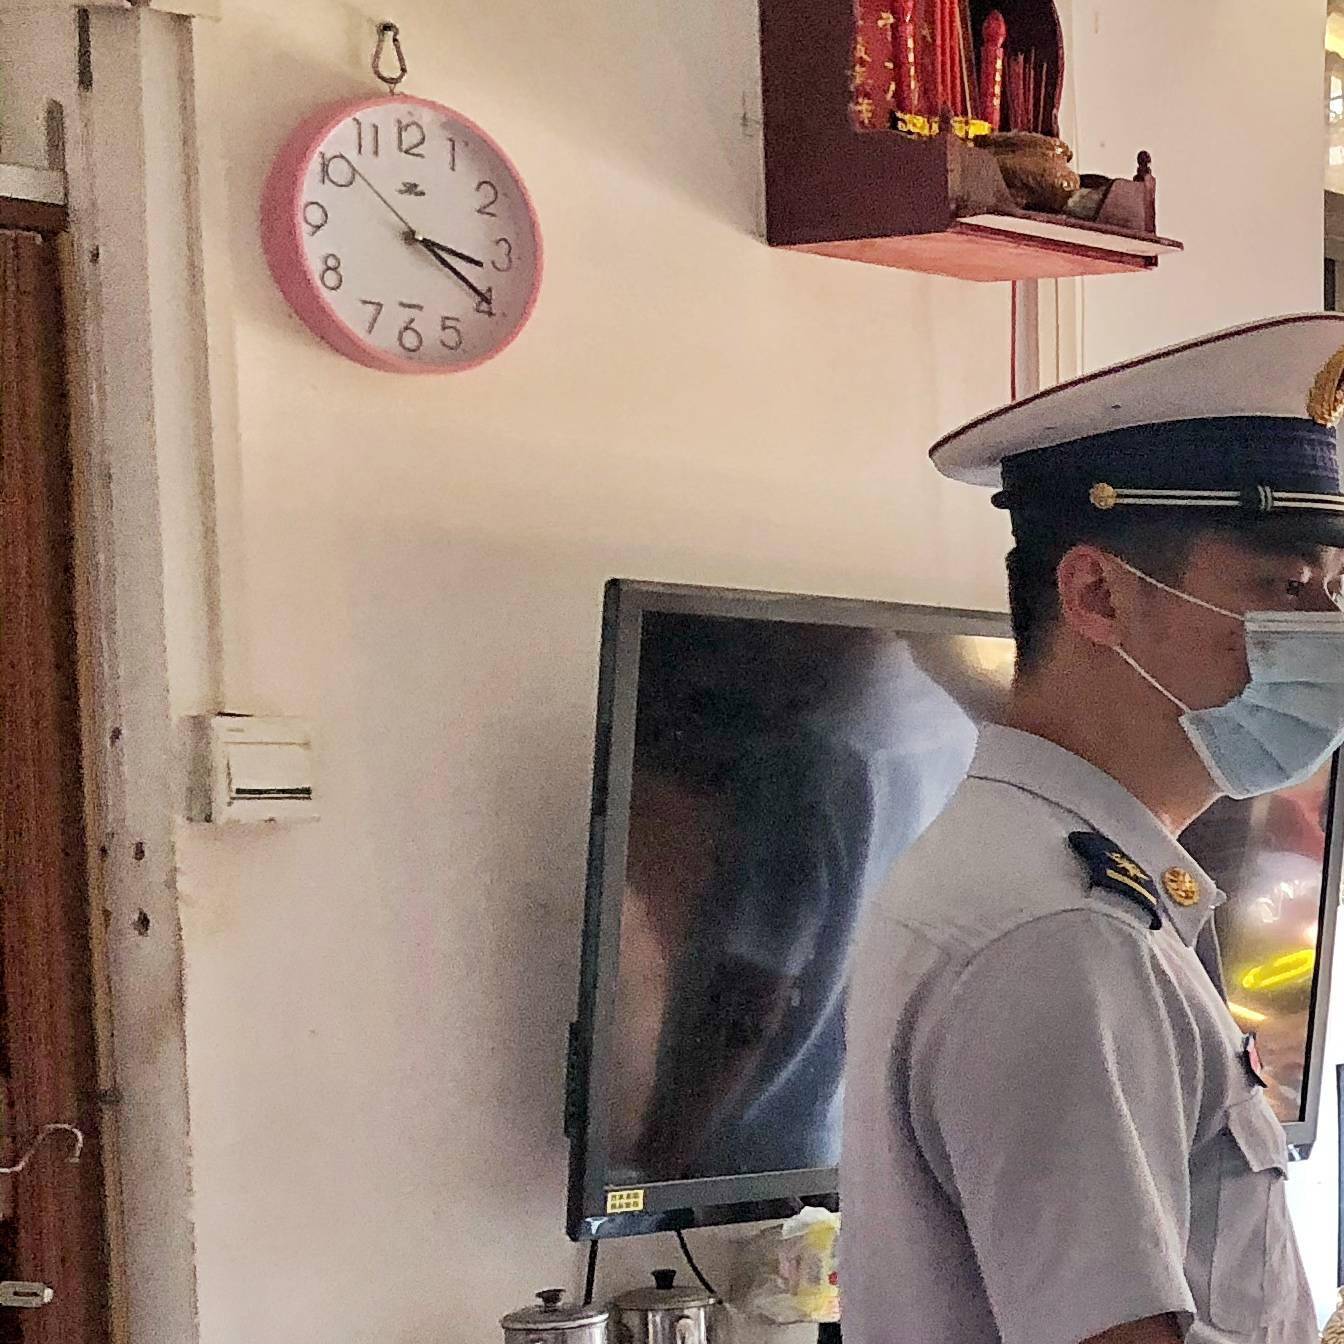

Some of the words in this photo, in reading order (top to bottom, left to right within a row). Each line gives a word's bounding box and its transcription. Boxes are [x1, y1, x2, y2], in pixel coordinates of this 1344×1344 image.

[352, 117, 380, 157] 11
[397, 119, 426, 158] 12
[446, 137, 457, 171] 1
[319, 150, 356, 188] 10
[474, 180, 498, 217] 2
[303, 201, 329, 236] 9
[320, 253, 343, 291] 8
[491, 237, 513, 273] 3
[360, 299, 384, 334] 7
[474, 286, 495, 318] 4
[398, 317, 423, 352] 6
[440, 316, 462, 351] 5
